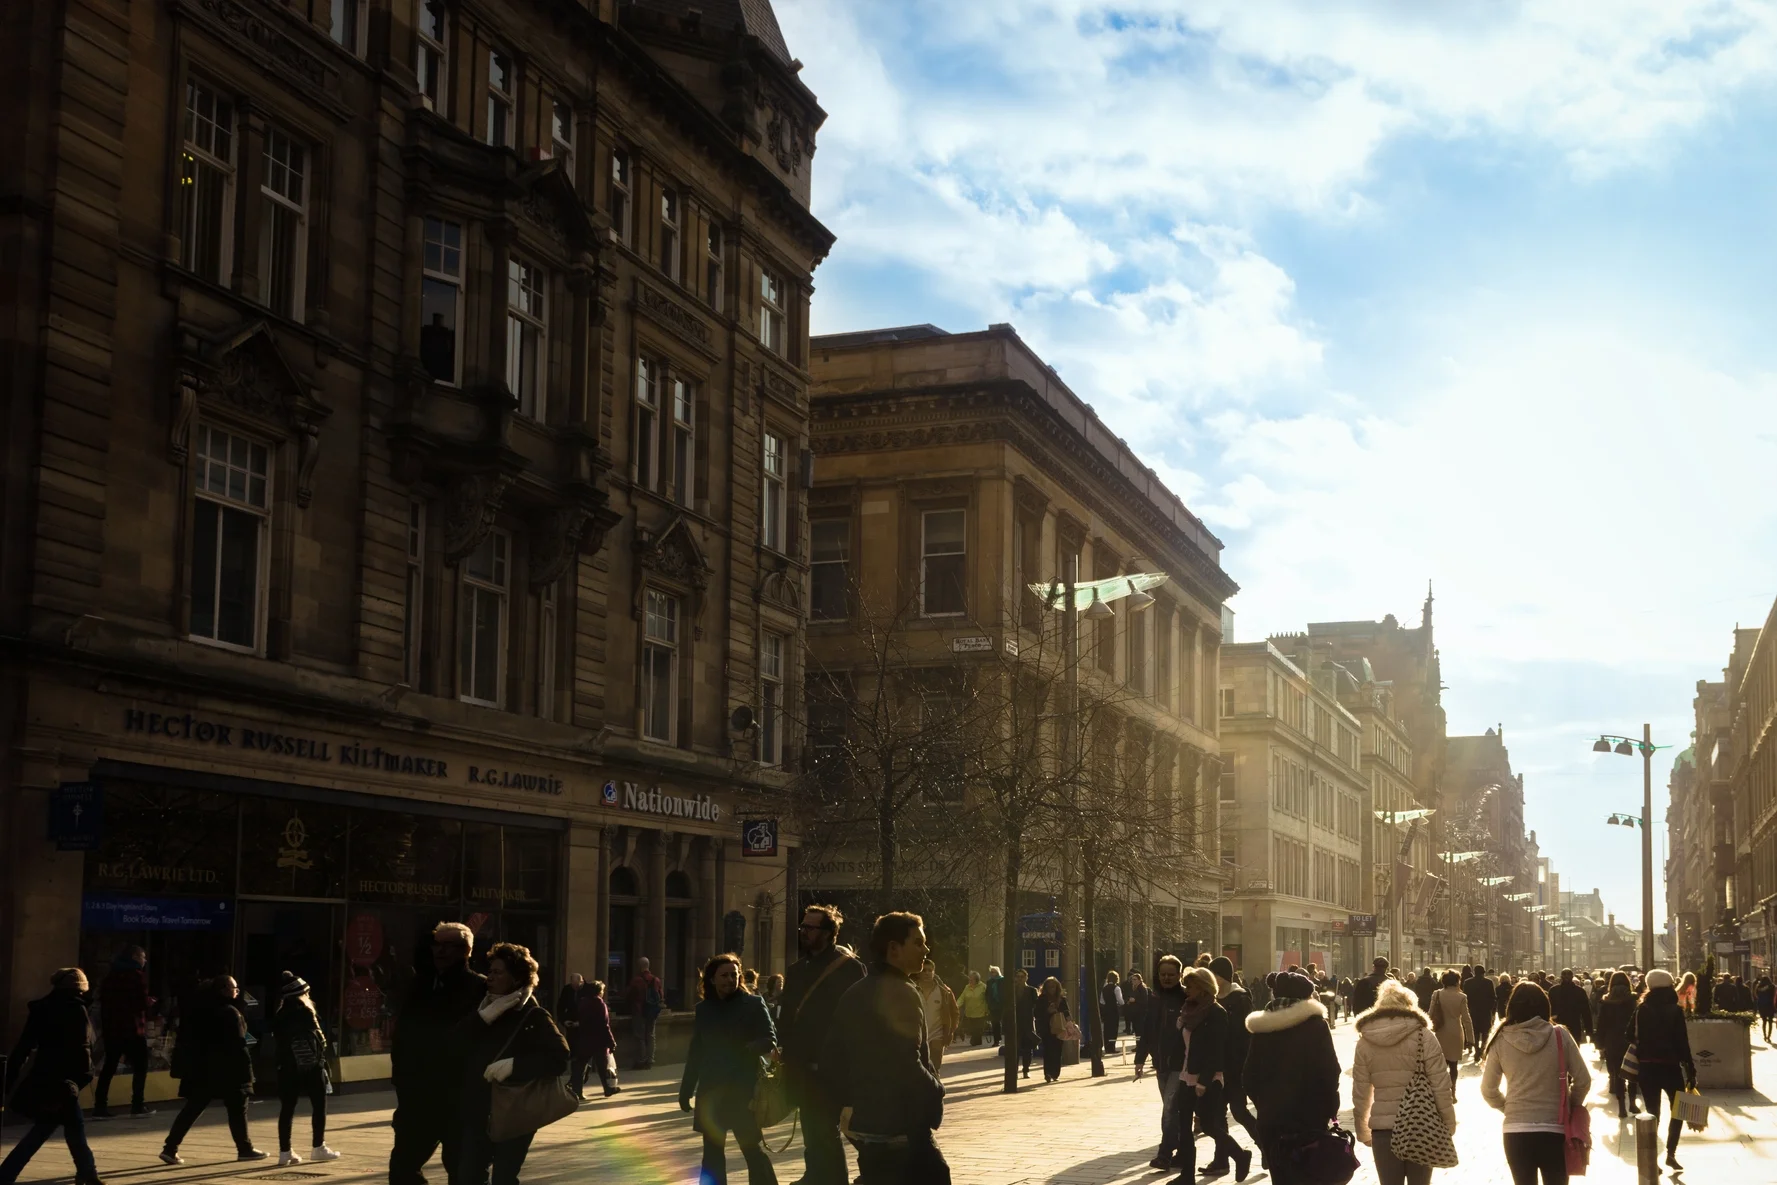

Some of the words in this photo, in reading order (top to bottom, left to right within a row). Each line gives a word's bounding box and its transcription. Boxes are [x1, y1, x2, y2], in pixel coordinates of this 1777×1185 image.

[241, 728, 332, 762] RUSSELL
[623, 781, 720, 822] Nationwide
[359, 880, 404, 894] HECTOR
[123, 914, 139, 924] Book
[162, 915, 180, 924] Travel
